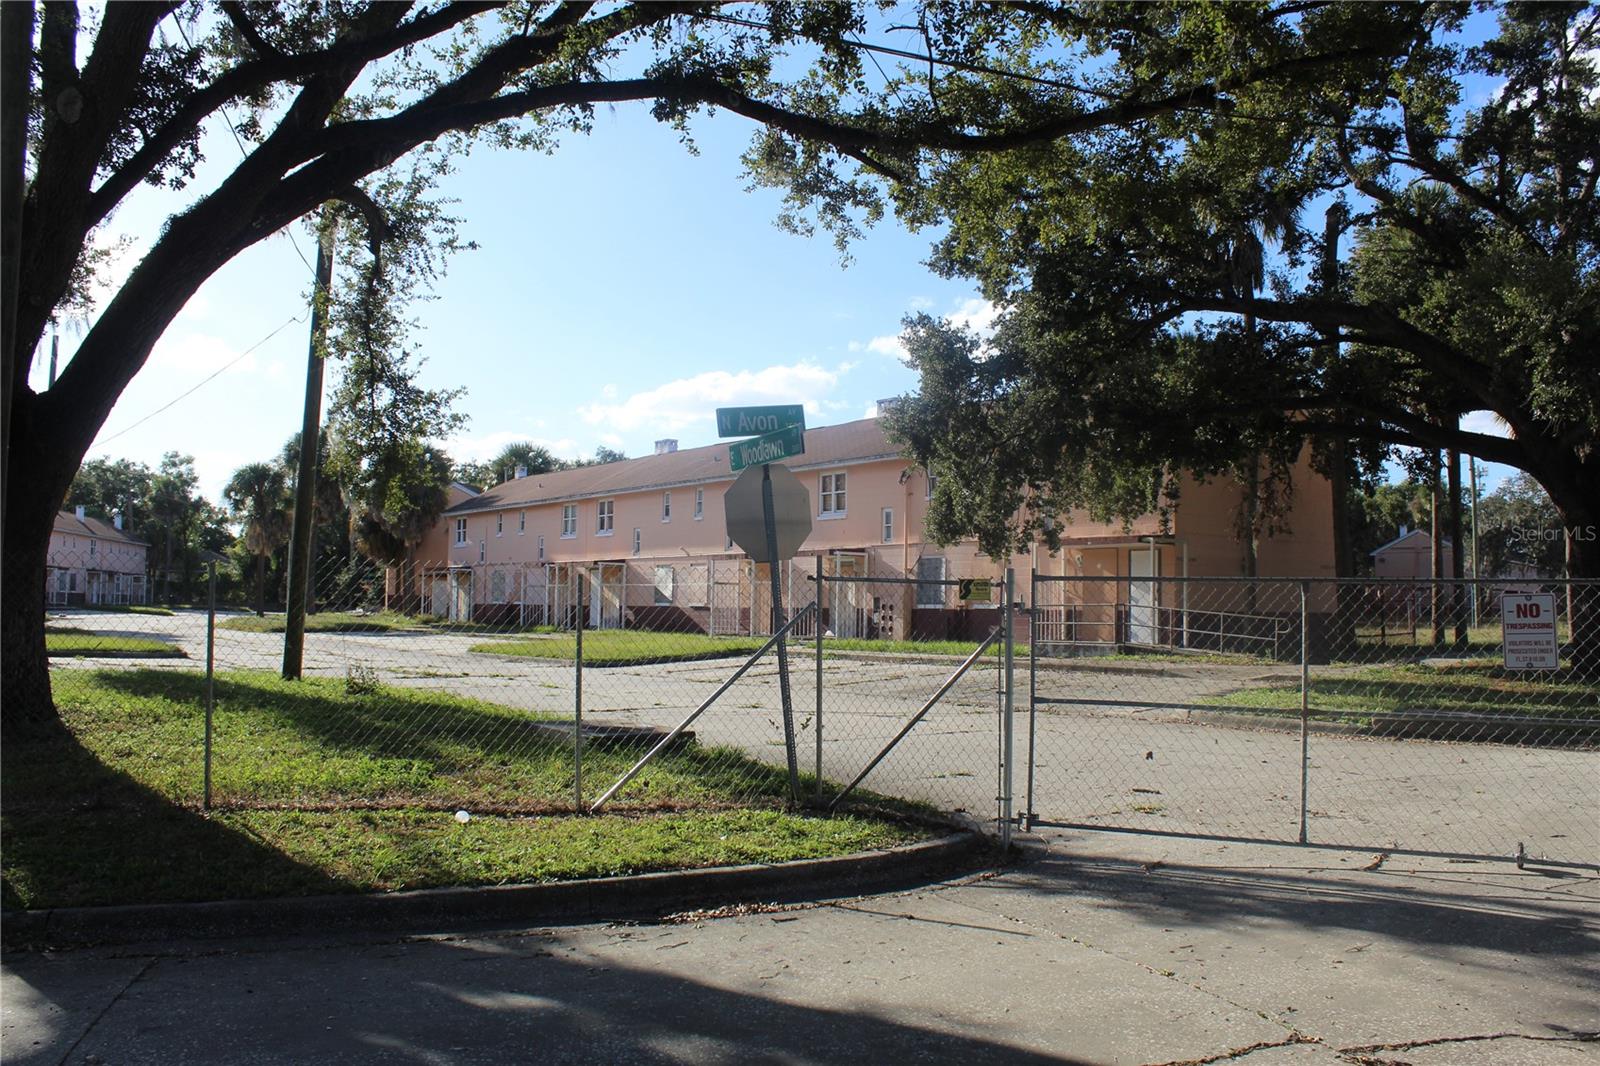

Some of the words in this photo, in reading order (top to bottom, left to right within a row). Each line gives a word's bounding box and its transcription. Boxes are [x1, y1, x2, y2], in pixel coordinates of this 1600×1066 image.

[723, 415, 731, 430] N
[738, 411, 779, 432] Avon
[740, 440, 785, 466] Woodlawn
[1516, 602, 1541, 619] NO
[1505, 622, 1553, 630] TRESPASSING
